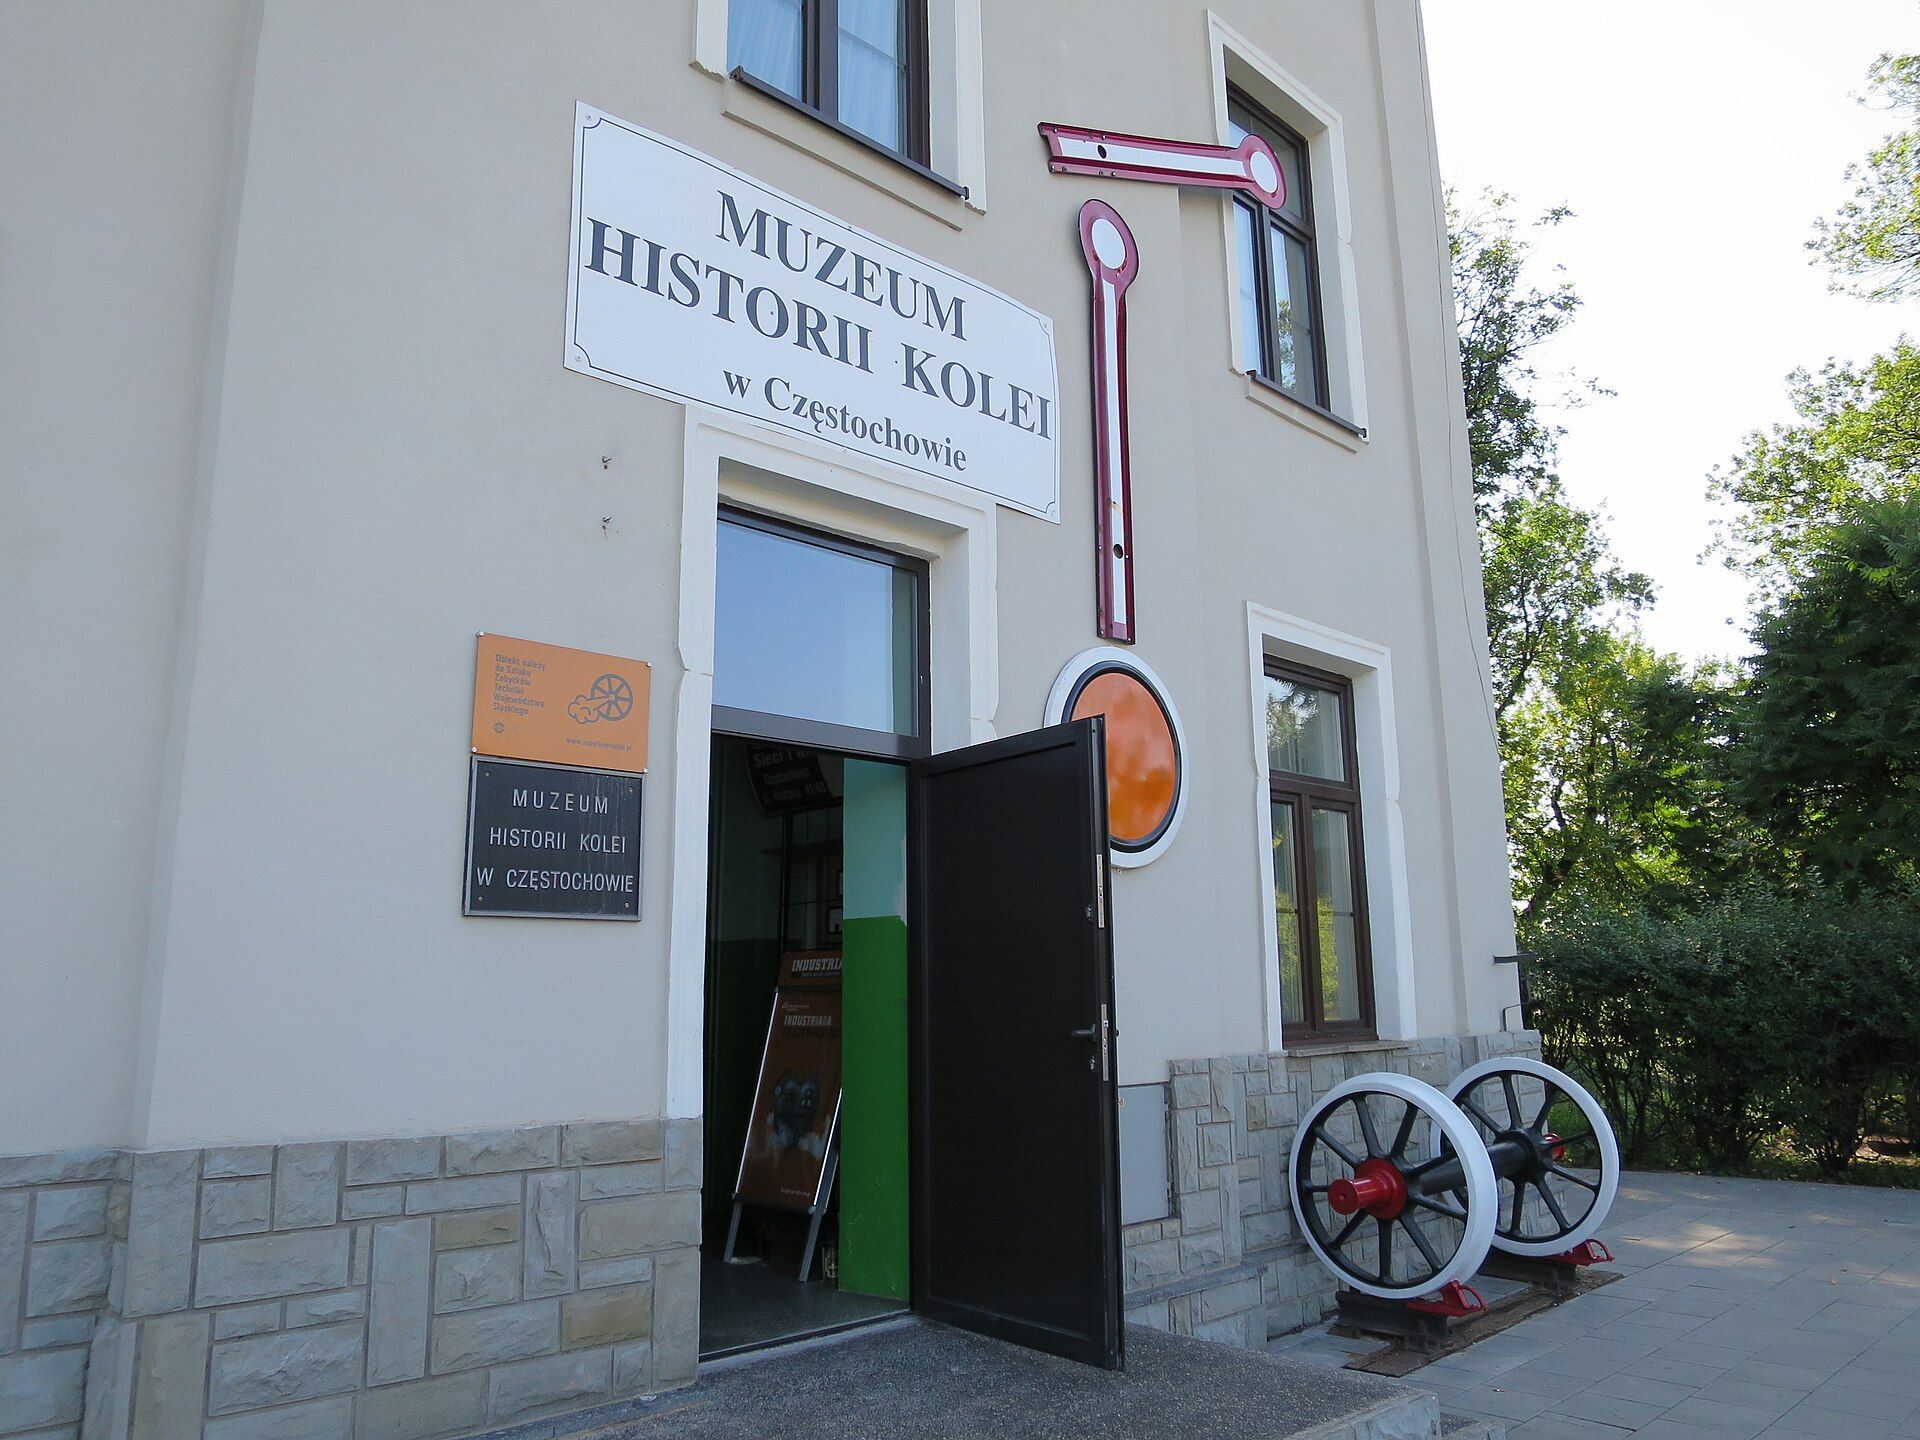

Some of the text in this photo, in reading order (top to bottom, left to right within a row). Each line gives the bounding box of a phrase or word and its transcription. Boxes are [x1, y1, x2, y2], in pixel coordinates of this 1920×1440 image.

[716, 190, 967, 341] MUZEUM
[584, 216, 1052, 440] HISTORII KOLEI
[723, 369, 968, 472] w Częstochowie
[494, 664, 532, 676] do Szlaku
[495, 653, 546, 671] Obiekt należy
[494, 672, 532, 686] Zabytków
[494, 683, 525, 695] Techniki
[492, 701, 529, 716] Śląskiego
[493, 692, 545, 708] Województwa
[512, 788, 609, 814] MUZEUM
[488, 826, 626, 854] HISTORII KOLEI
[476, 867, 635, 894] W CZĘSTOCHOWIE
